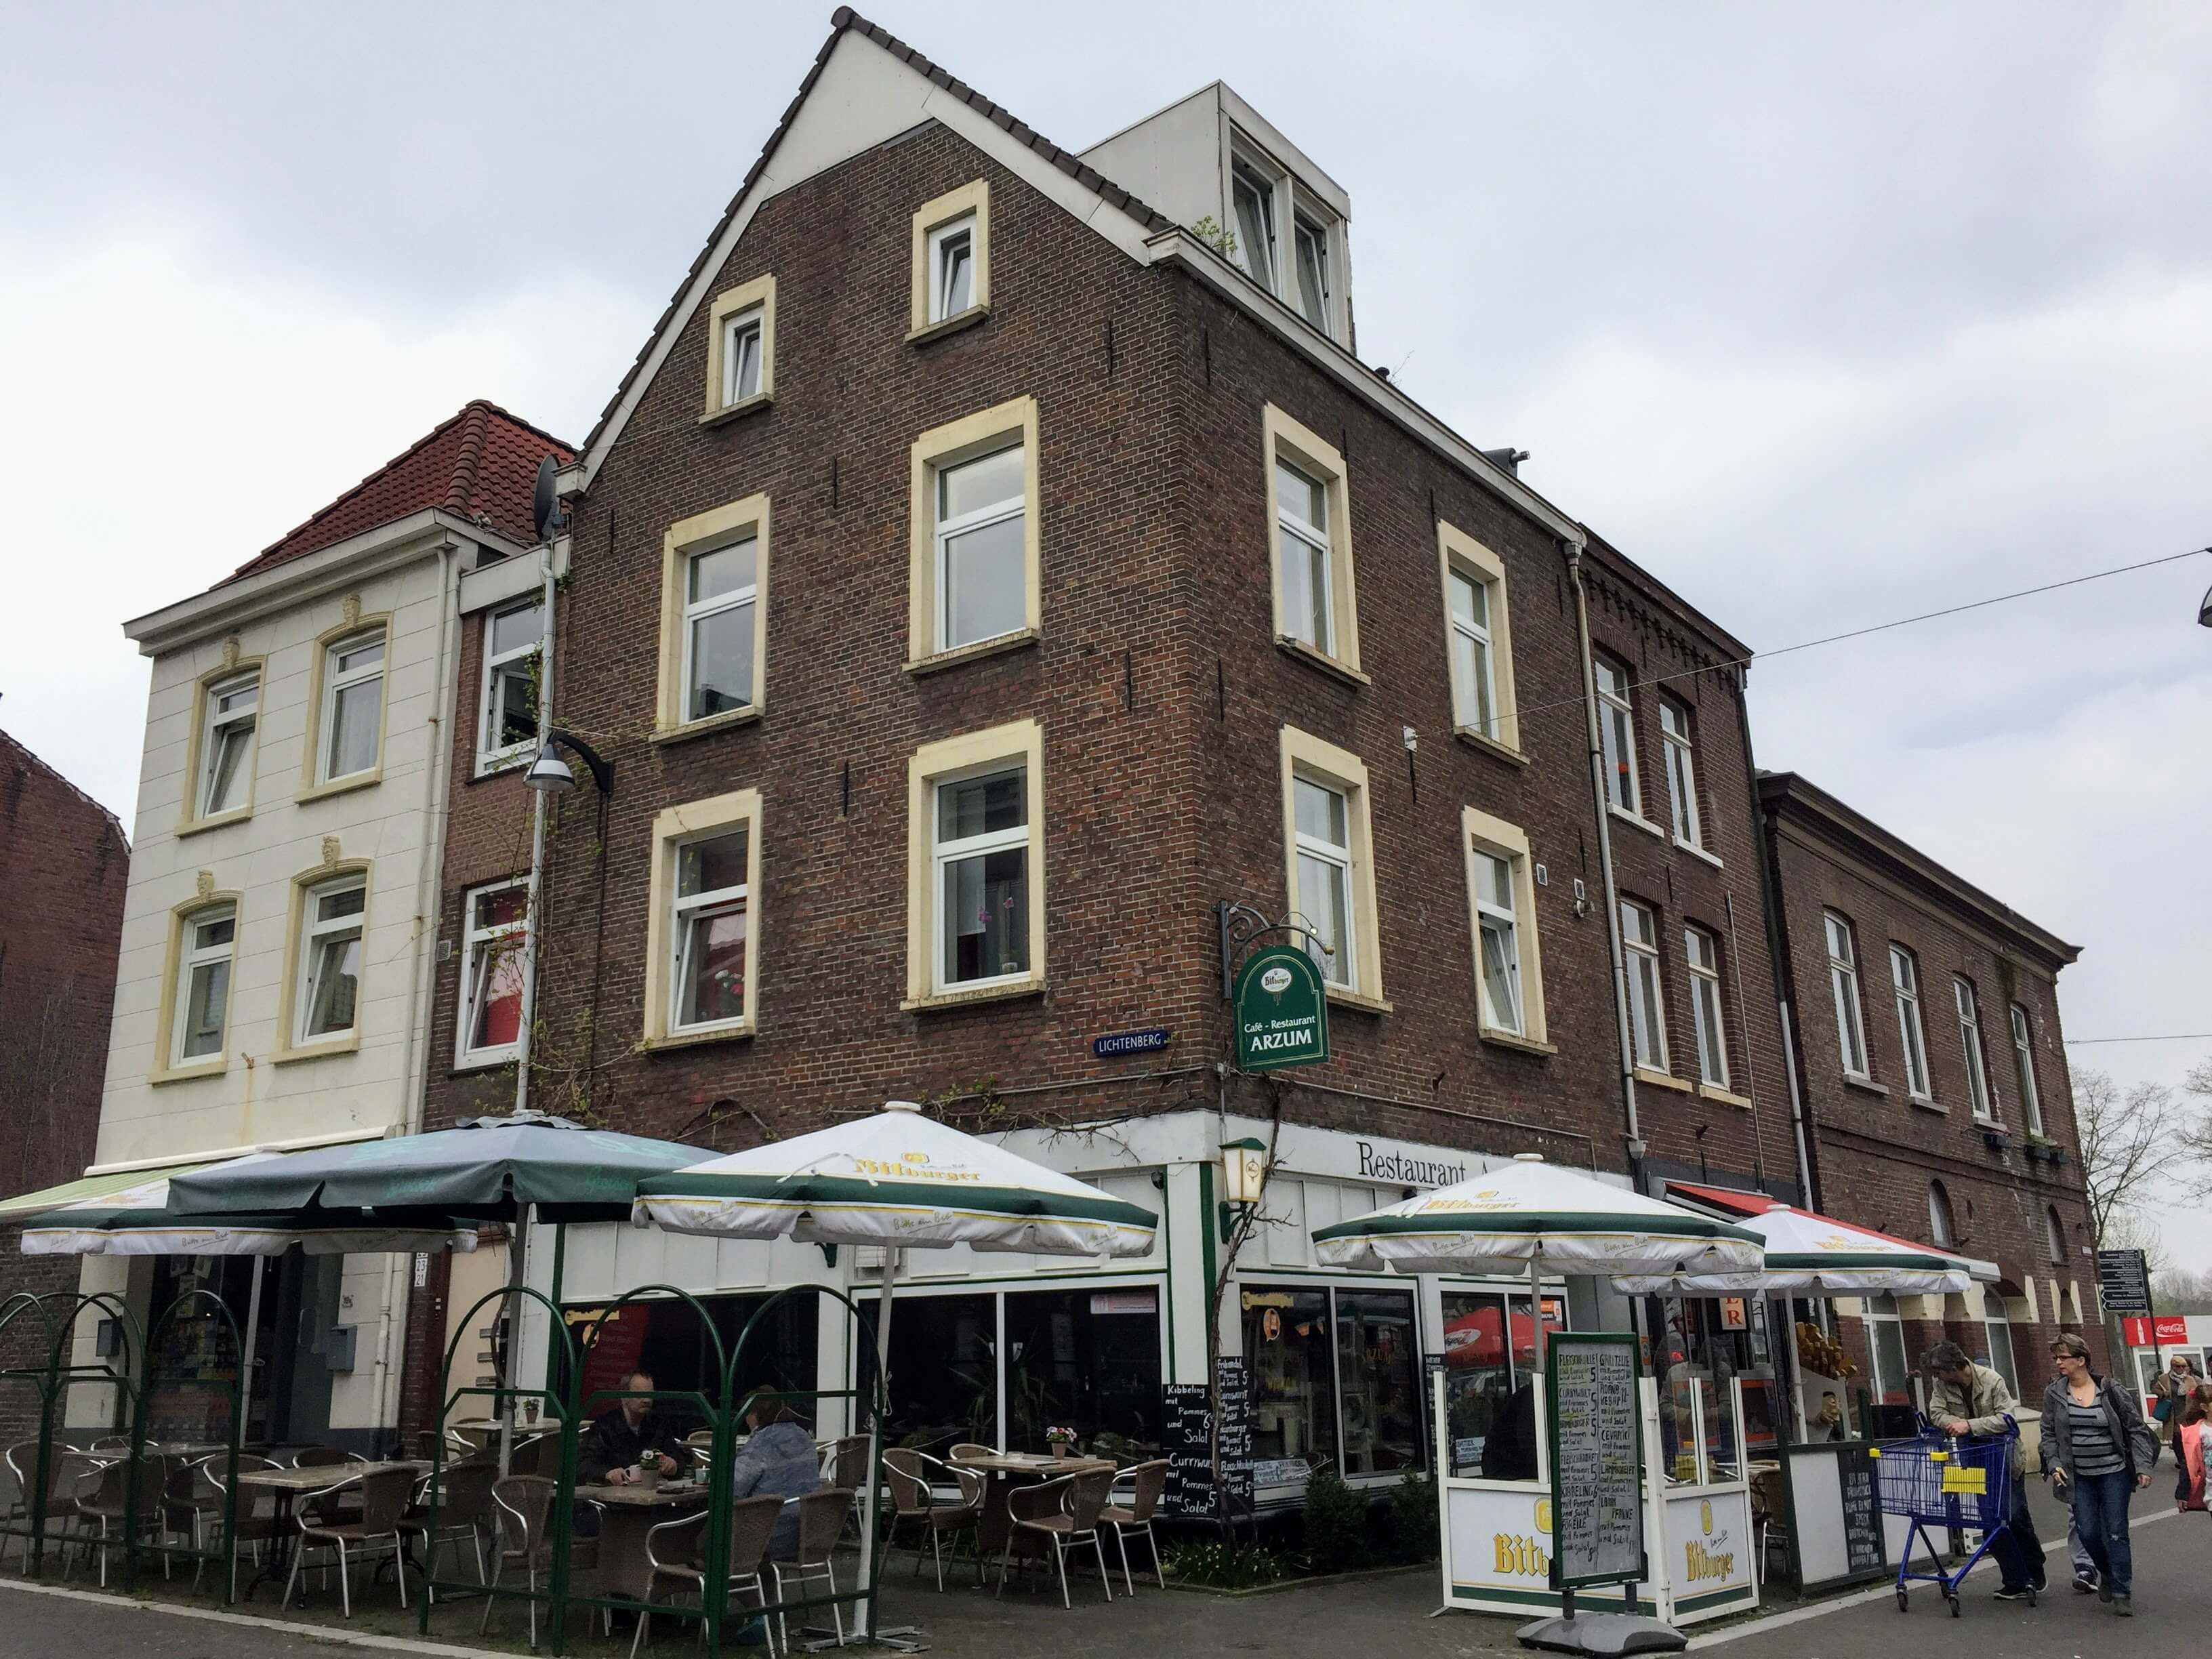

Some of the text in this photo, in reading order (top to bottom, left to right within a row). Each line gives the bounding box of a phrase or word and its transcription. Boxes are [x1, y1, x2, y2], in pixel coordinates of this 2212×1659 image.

[1244, 1022, 1263, 1033] Café
[1271, 1015, 1315, 1029] Restaurant
[1099, 1033, 1162, 1052] LICHTENBERG
[1250, 1029, 1313, 1052] ARZUM
[856, 1160, 981, 1181] Bitburger
[1356, 1141, 1466, 1186] Restaurant
[417, 1259, 426, 1271] 23
[2156, 1323, 2185, 1335] Coca-Cola
[1590, 1367, 1596, 1382] 5
[1167, 1385, 1206, 1399] Kibbeling
[1165, 1397, 1179, 1405] mit
[1591, 1392, 1597, 1412] 5
[1178, 1406, 1208, 1416] Pommes
[1167, 1419, 1183, 1429] und
[1591, 1418, 1597, 1437] 5
[1591, 1463, 1597, 1480] 5
[1182, 1478, 1214, 1491] Pommes
[1166, 1494, 1183, 1503] und
[1181, 1498, 1209, 1515] Salat
[1685, 1539, 1734, 1582] Bitburger
